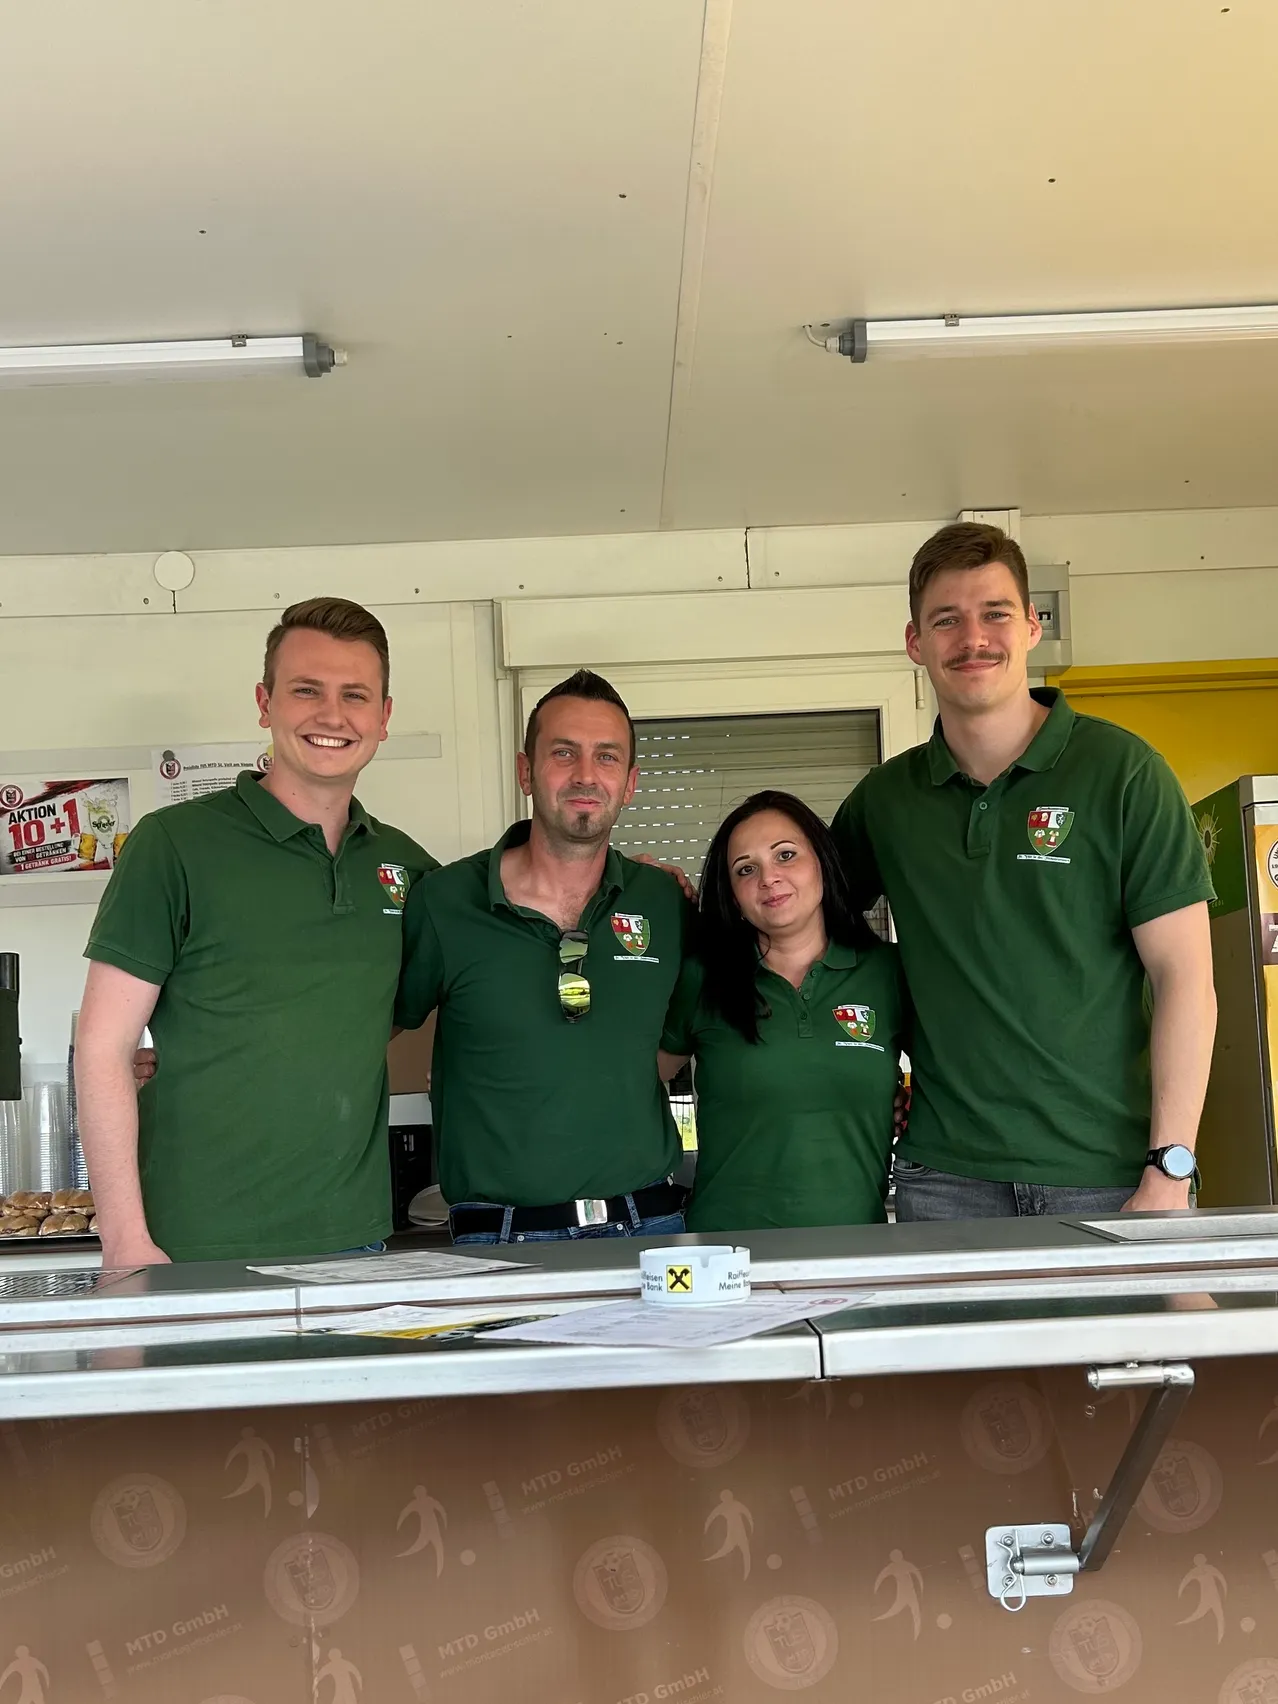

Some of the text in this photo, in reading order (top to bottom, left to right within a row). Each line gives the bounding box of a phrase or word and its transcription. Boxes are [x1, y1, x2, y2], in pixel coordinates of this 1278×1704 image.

[8, 803, 57, 825] AKTION
[25, 860, 50, 869] GETRÄNK
[50, 855, 72, 865] GRATIS!
[647, 1282, 663, 1291] Bank
[719, 1282, 741, 1291] Meine
[521, 1444, 623, 1497] MTD GmbH
[827, 1451, 929, 1502] MTD GmbH
[0, 1546, 57, 1578] GmbH
[124, 1604, 230, 1656] MTD GmbH
[438, 1607, 541, 1660] MTD GmbH
[654, 1666, 710, 1699] GmbH
[962, 1670, 1018, 1704] GmbH
